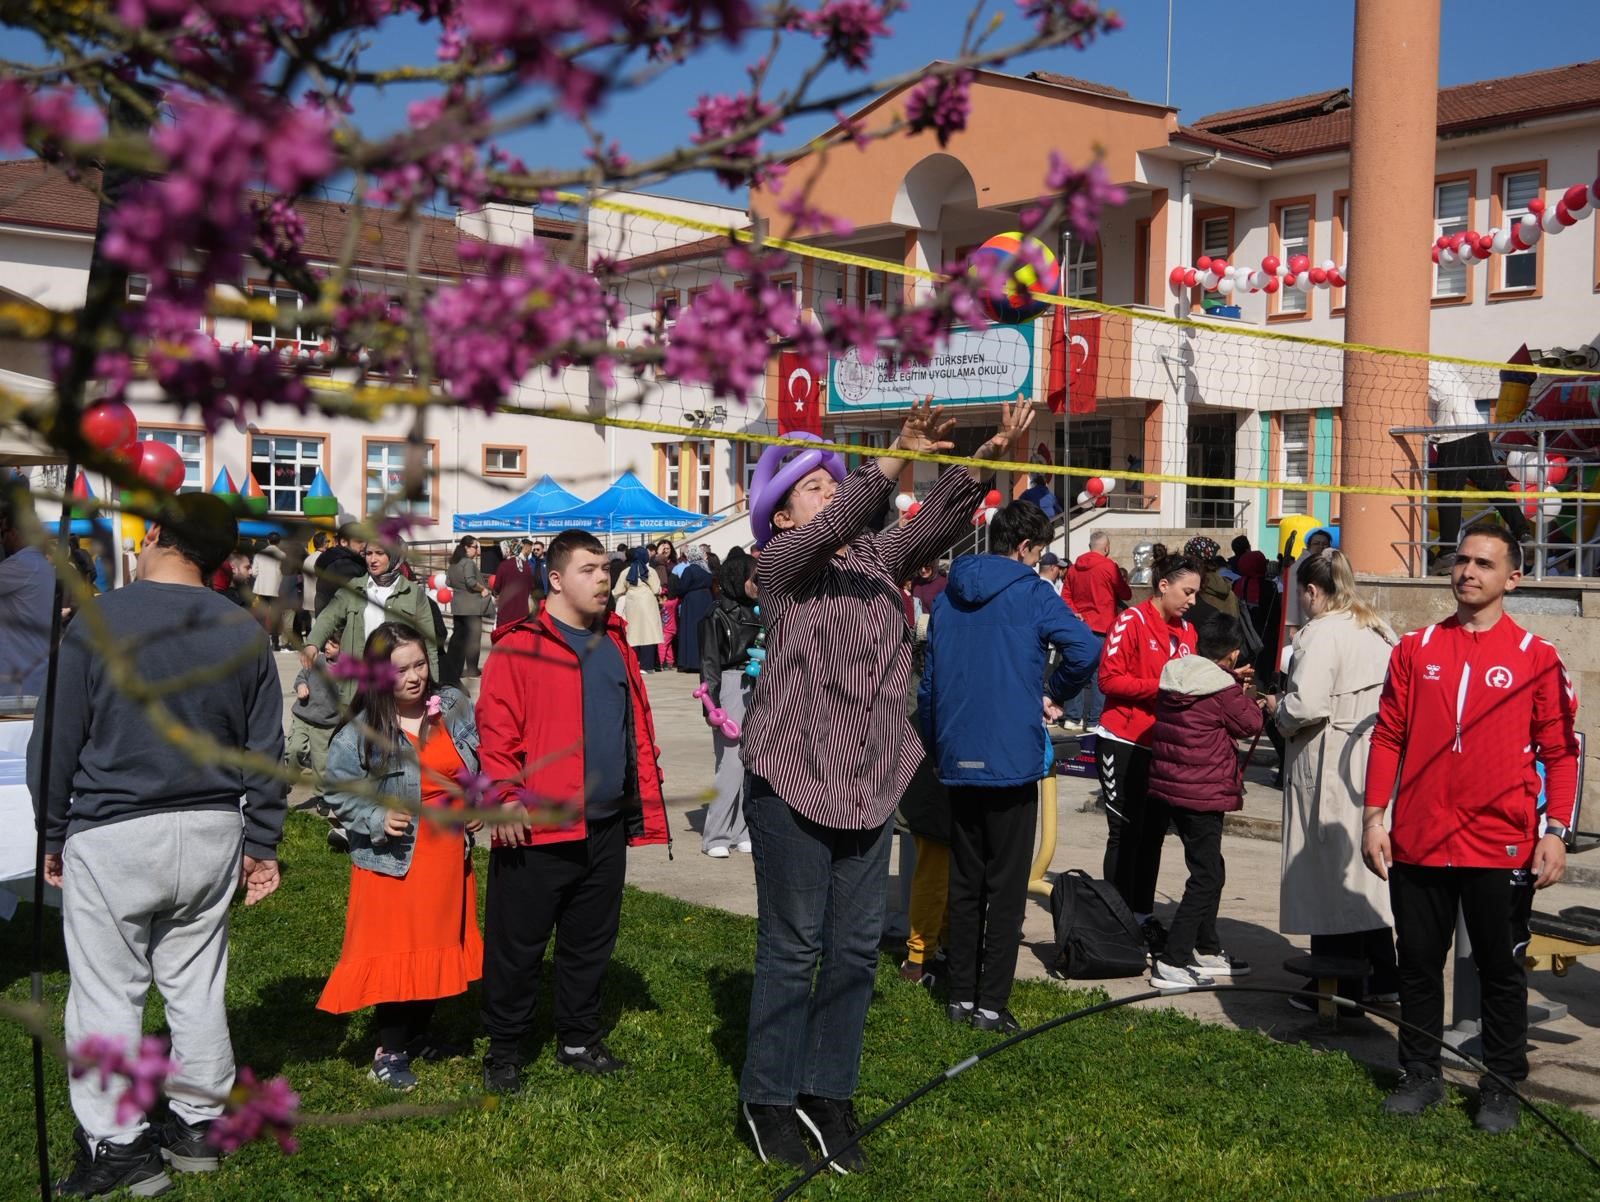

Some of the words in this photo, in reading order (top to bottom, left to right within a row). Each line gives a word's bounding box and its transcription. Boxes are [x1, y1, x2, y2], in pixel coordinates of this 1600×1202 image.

[928, 367, 976, 379] UYGULAMA
[978, 364, 1008, 376] OKULU
[640, 518, 663, 527] DÜZCE
[664, 518, 703, 527] BELEDİSİ
